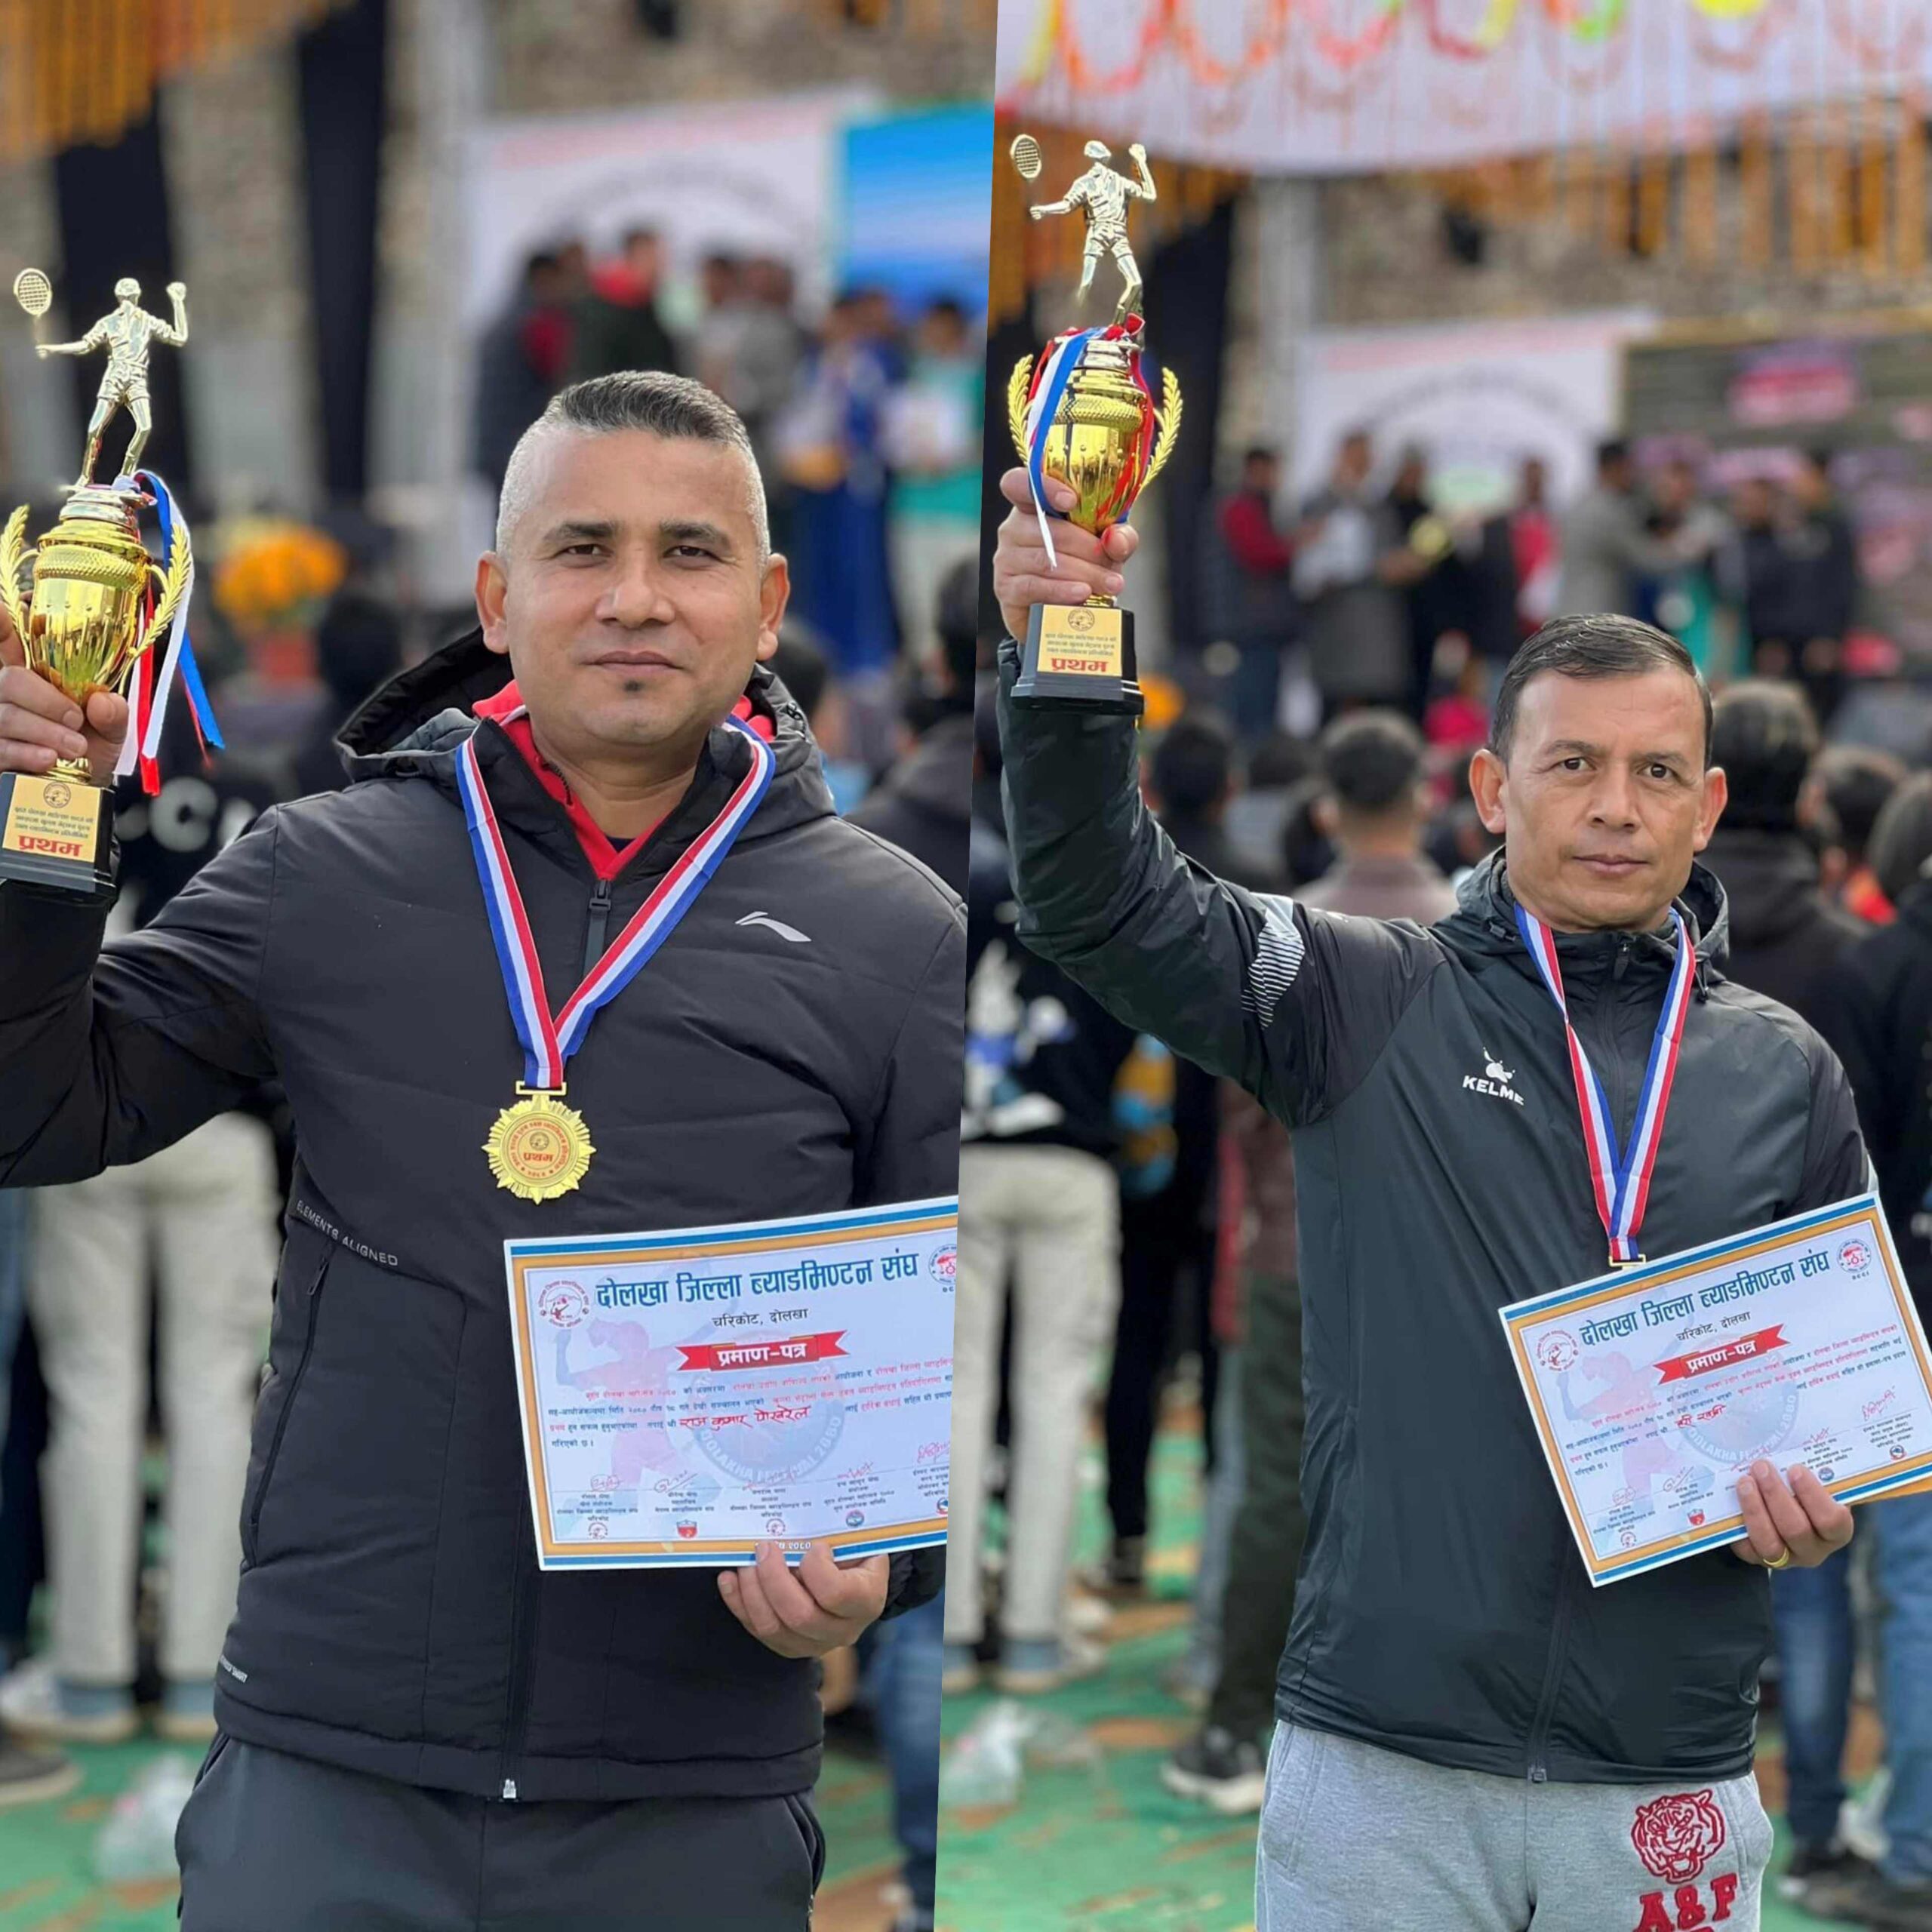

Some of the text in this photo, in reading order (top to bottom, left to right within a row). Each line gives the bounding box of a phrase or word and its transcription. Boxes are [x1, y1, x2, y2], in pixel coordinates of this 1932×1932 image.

[1051, 658, 1109, 672] प्रथम
[18, 835, 83, 857] प्रथम
[297, 1200, 398, 1266] ELEMENTS ALIGNED
[596, 1278, 669, 1309] दोलखा
[675, 1272, 742, 1303] जिल्ला
[881, 1247, 919, 1281] संघ
[1579, 1319, 1639, 1346] दोलखा
[1641, 1293, 1695, 1327] जिल्ला
[1798, 1248, 1830, 1278] संघ
[769, 1308, 808, 1324] दोलखा
[1720, 1311, 1751, 1329] दोलखा
[716, 1343, 808, 1367] प्रमाण-पत्र
[1686, 1340, 1758, 1374] प्रमाण-पत्र
